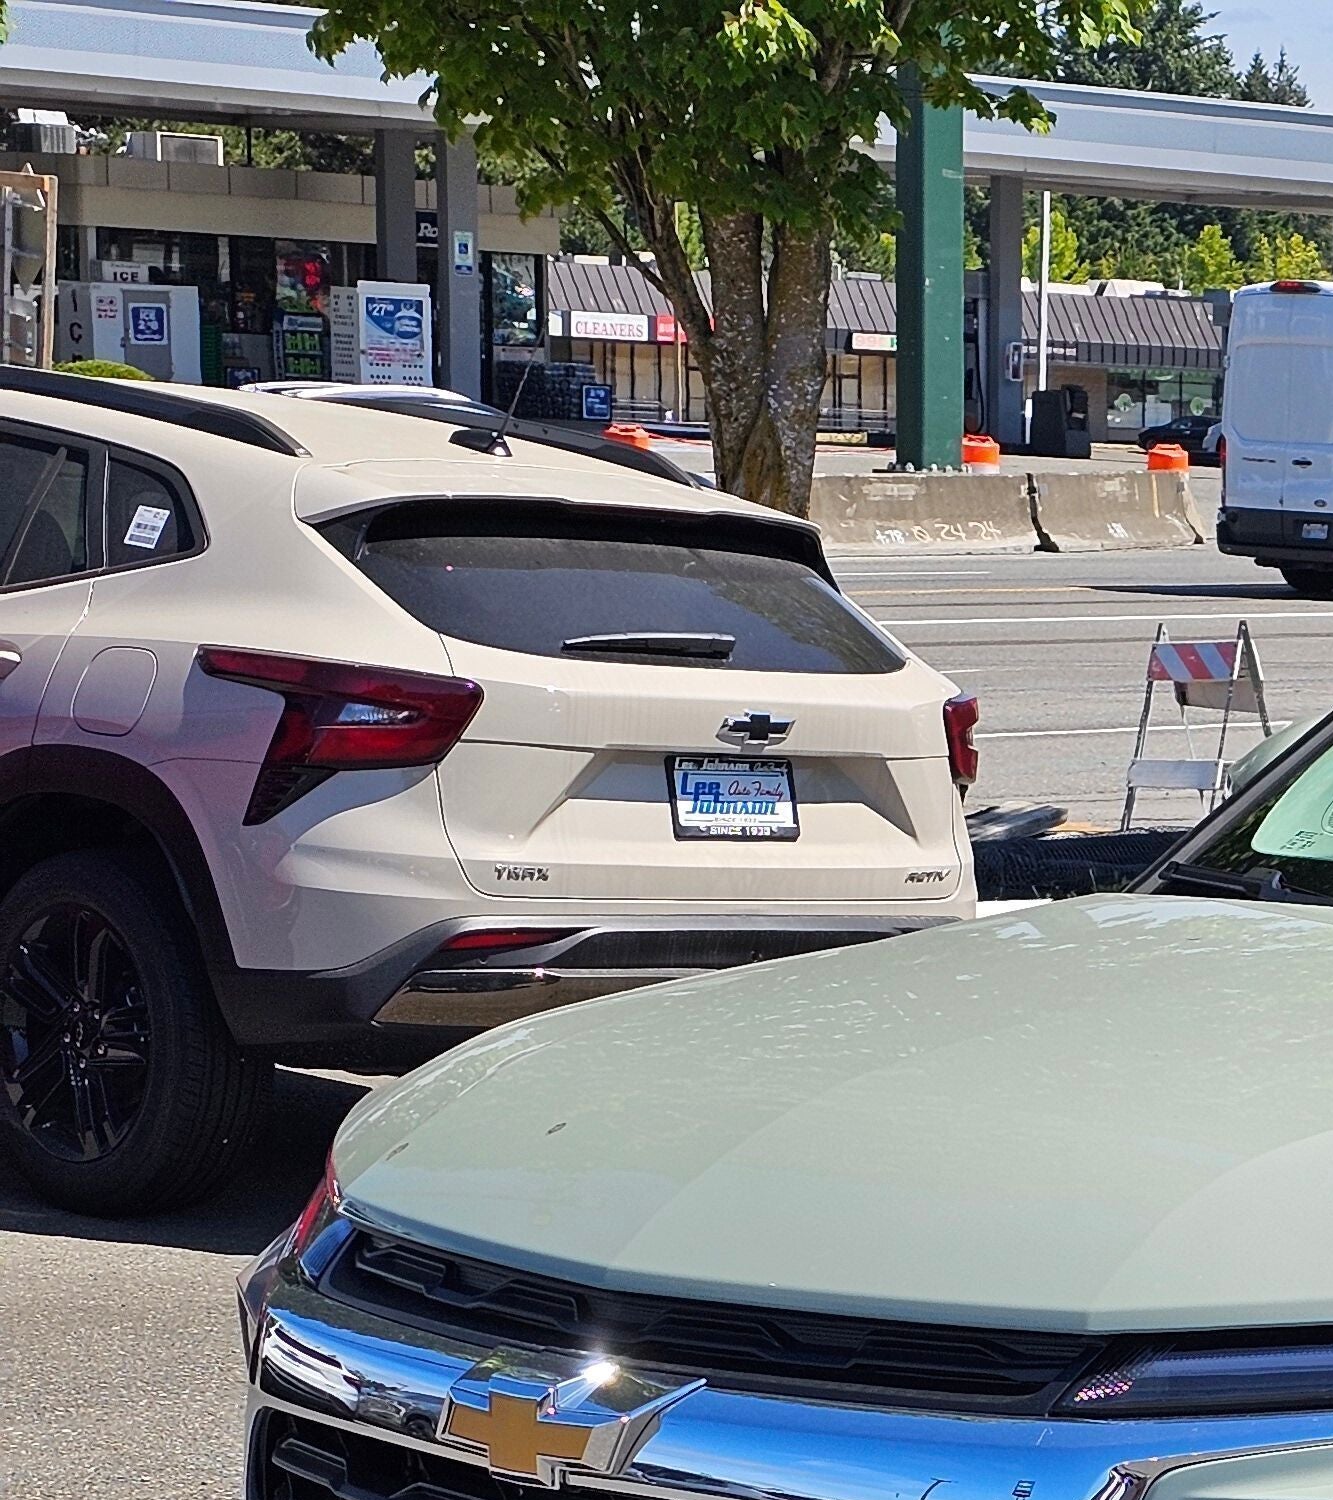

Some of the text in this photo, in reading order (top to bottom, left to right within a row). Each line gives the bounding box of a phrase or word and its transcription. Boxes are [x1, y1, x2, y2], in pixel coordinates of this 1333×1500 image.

[113, 271, 139, 282] ICE
[575, 319, 644, 337] CLEANERS
[680, 771, 725, 797] Lee
[752, 780, 784, 802] Family
[685, 792, 780, 816] Johnson
[709, 826, 742, 836] SINCE
[494, 863, 549, 882] TRAX
[904, 869, 951, 884] ACTIV
